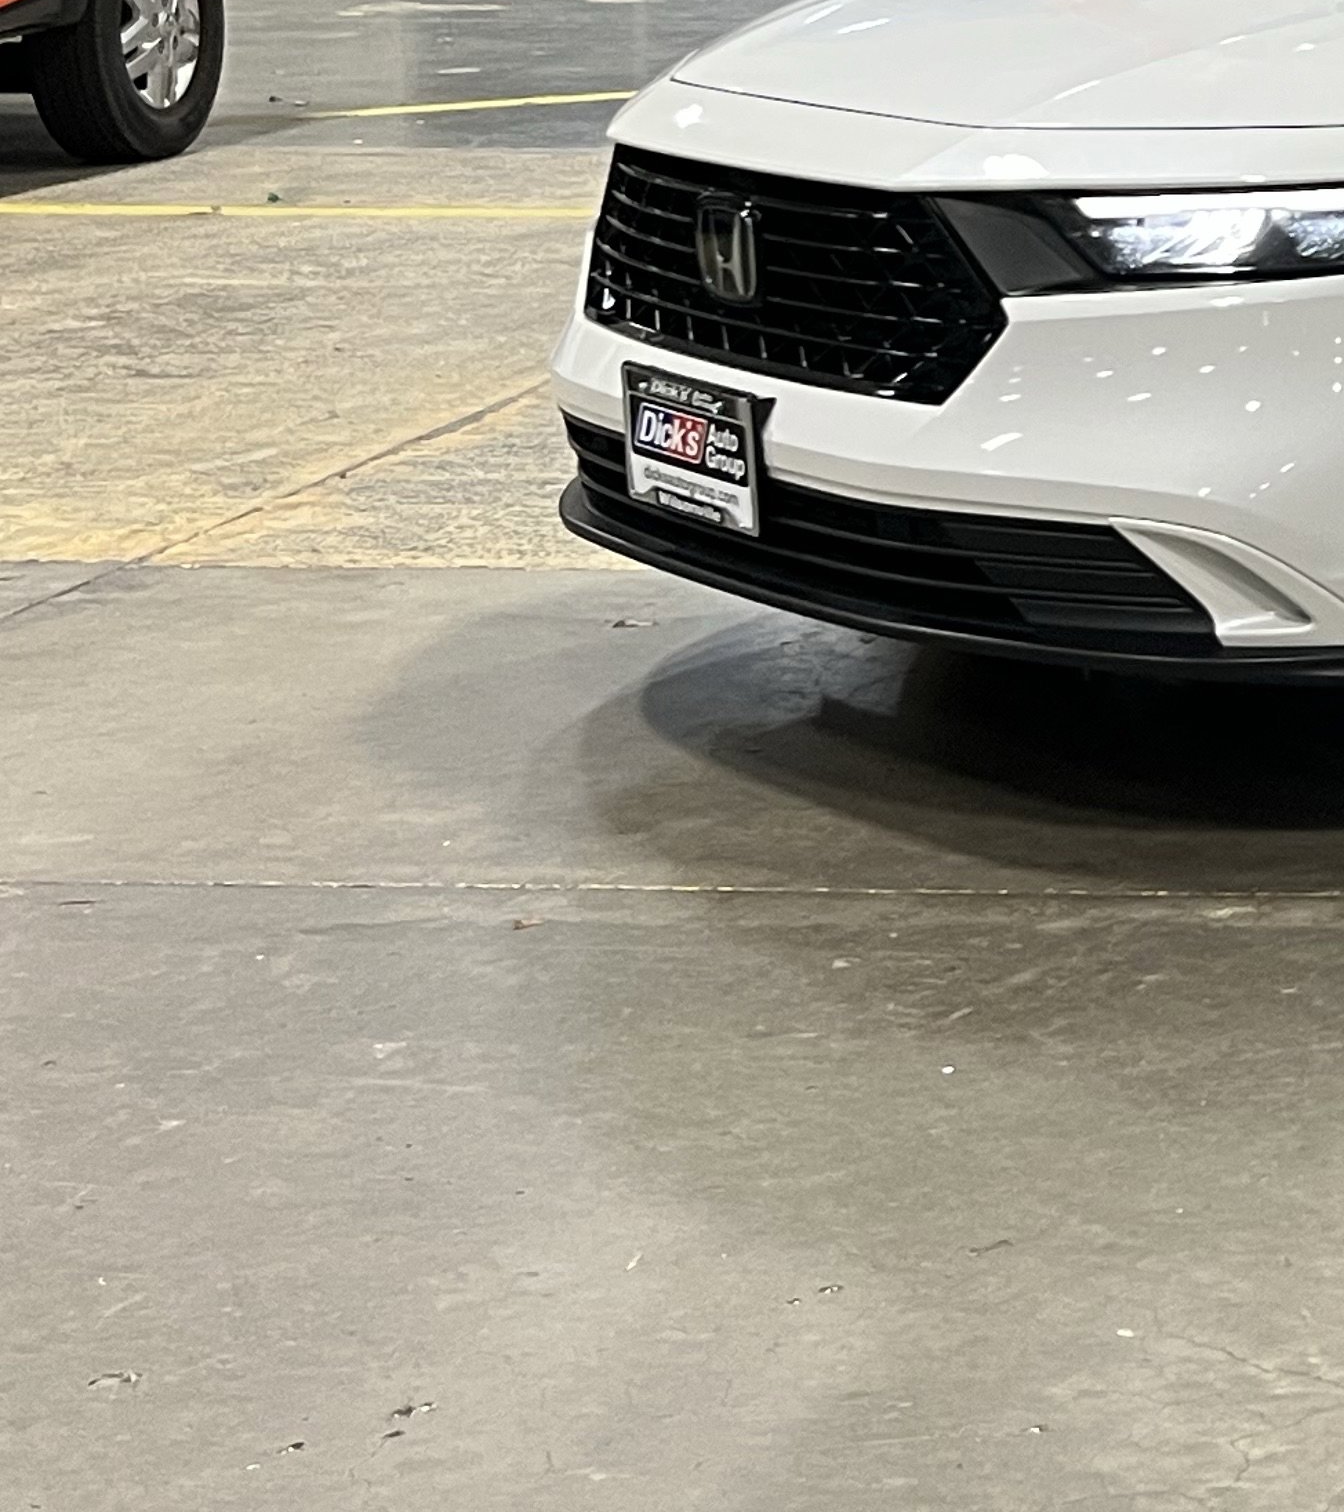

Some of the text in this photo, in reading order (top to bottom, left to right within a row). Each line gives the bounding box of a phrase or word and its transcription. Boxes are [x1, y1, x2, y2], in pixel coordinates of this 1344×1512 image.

[638, 409, 700, 457] Dick's
[706, 423, 739, 453] Auto
[704, 444, 746, 481] Group
